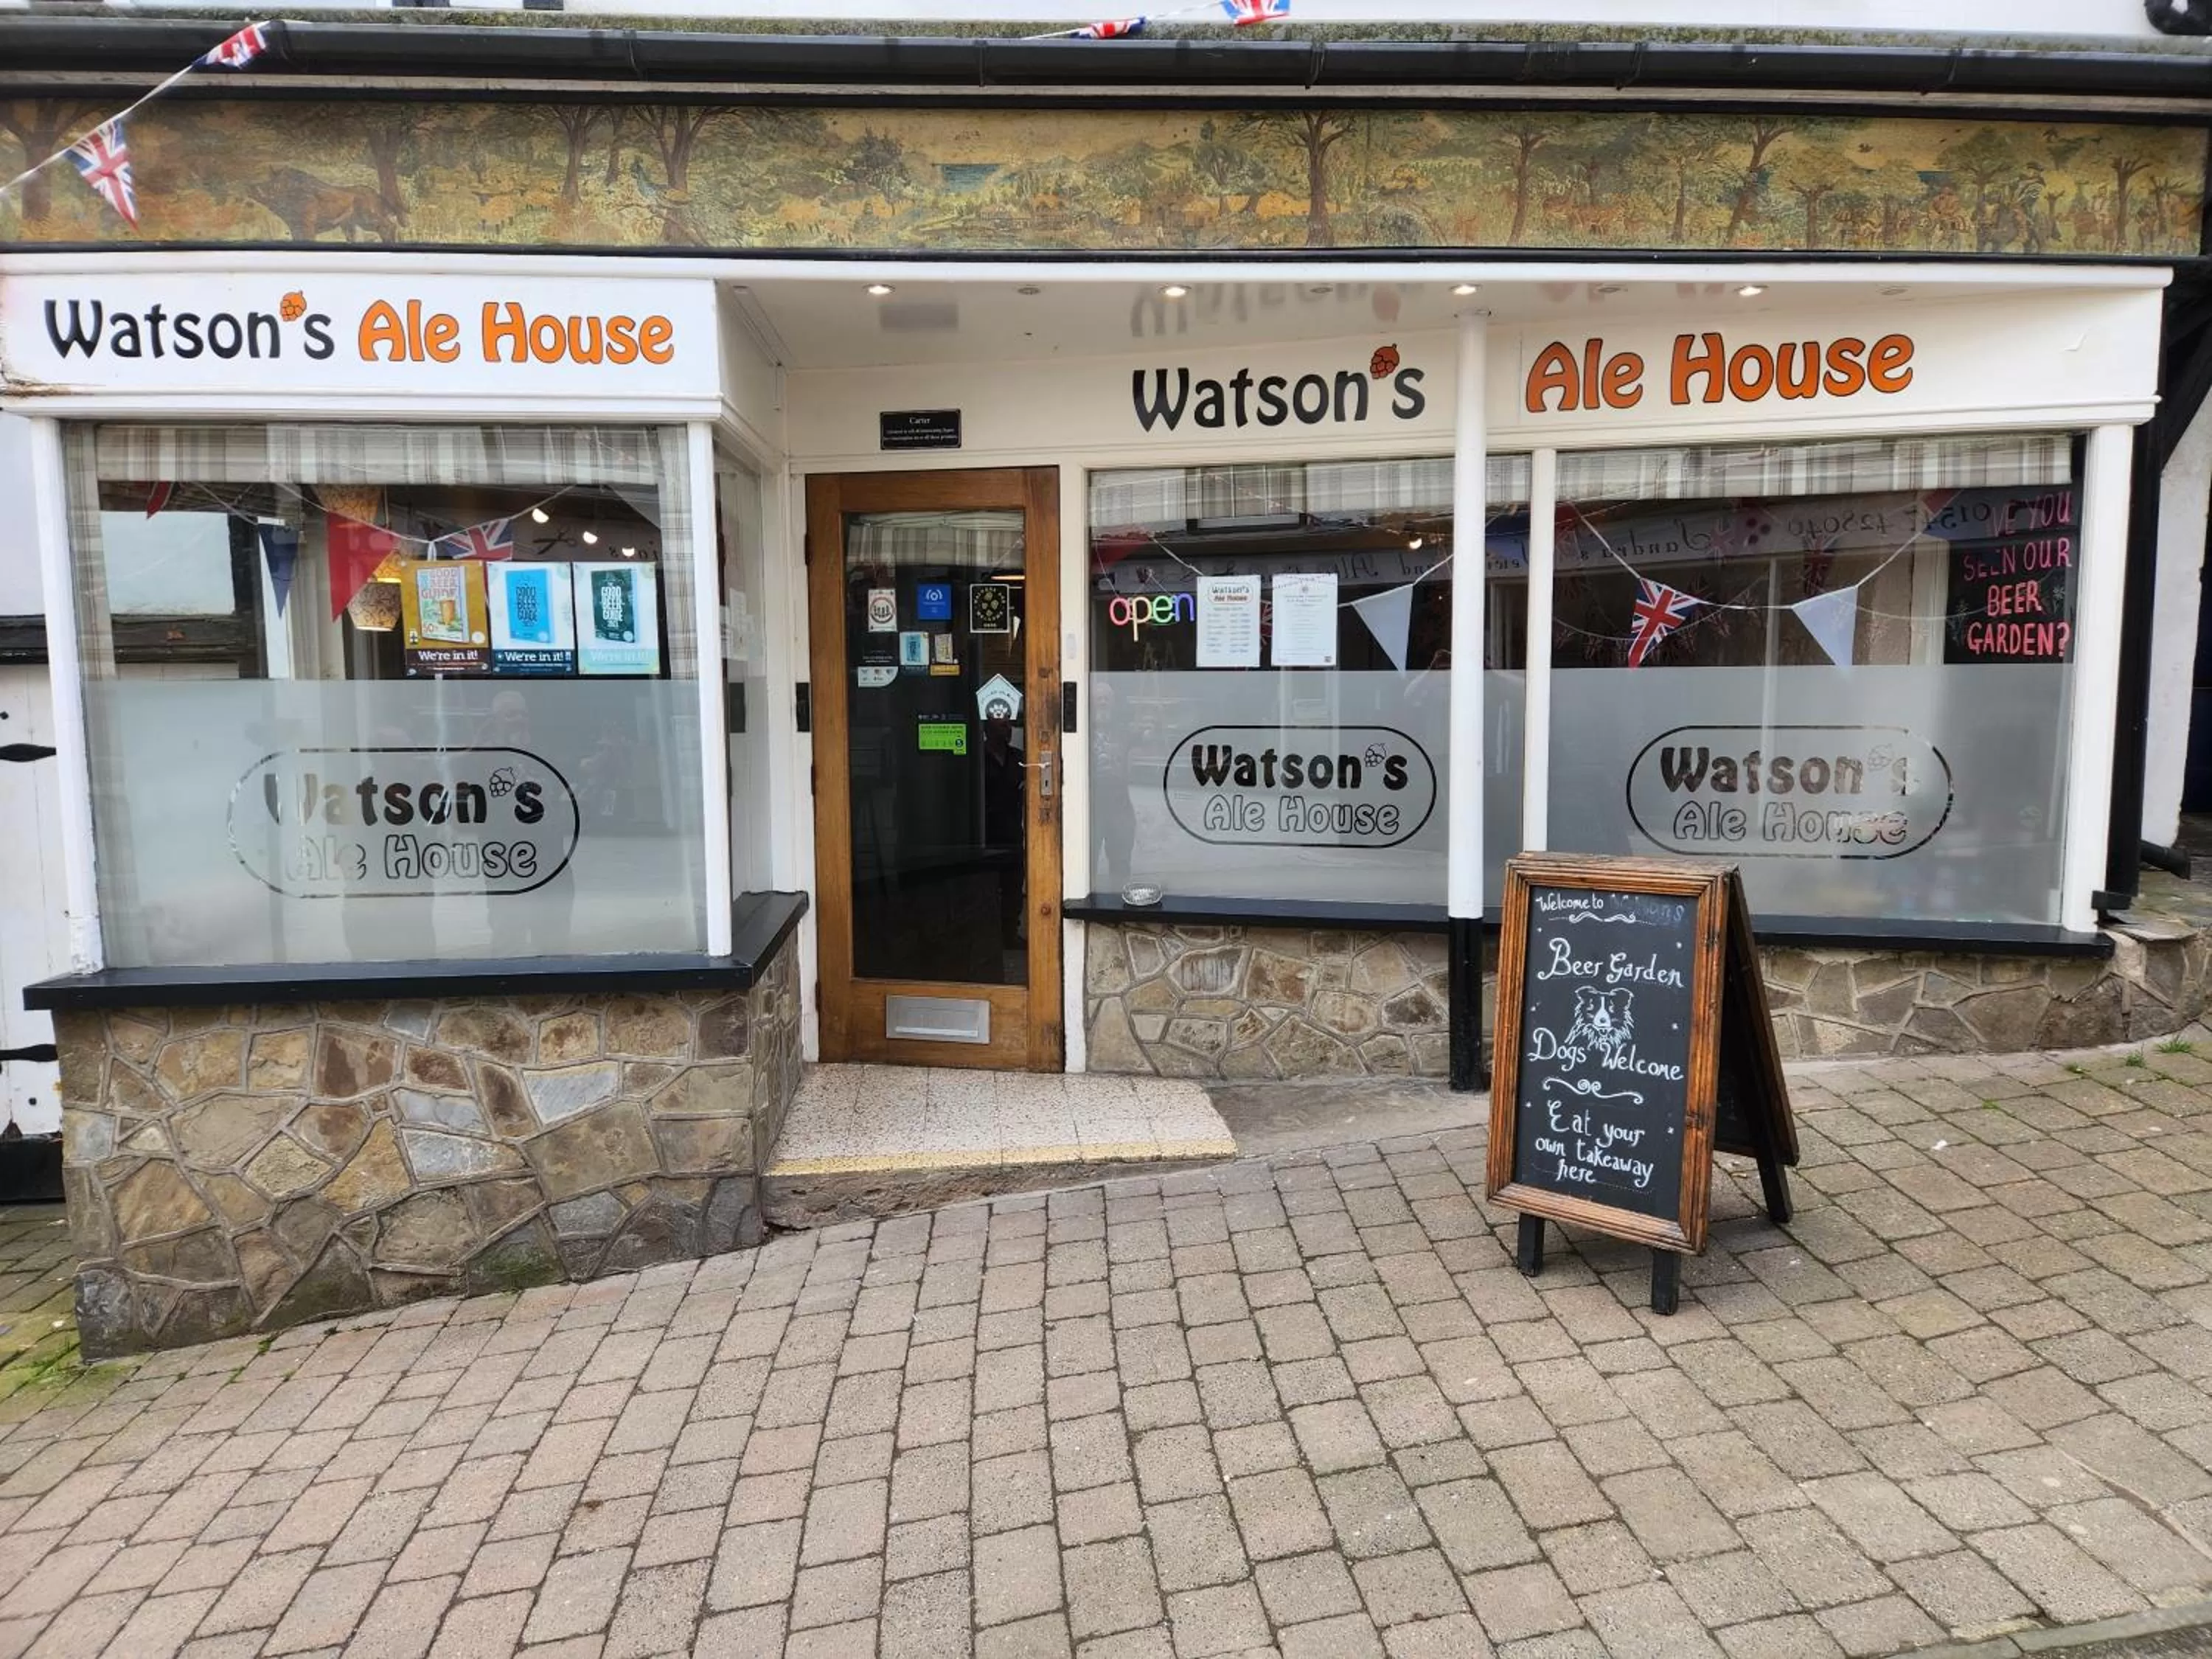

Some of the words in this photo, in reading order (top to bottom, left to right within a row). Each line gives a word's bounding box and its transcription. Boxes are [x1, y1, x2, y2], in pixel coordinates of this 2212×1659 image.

[44, 292, 335, 359] Watson's
[358, 299, 461, 363] Ale
[481, 301, 675, 365] House
[1132, 344, 1426, 431] Watson's
[1526, 340, 1645, 413] Ale
[1670, 333, 1916, 405] House
[2028, 490, 2071, 531] YOU
[2023, 538, 2073, 571] OUR
[1109, 592, 1196, 641] open
[1987, 580, 2042, 617] BEER
[418, 650, 449, 661] We're
[453, 650, 465, 660] in
[467, 649, 479, 660] it!
[504, 651, 537, 661] We're
[539, 651, 551, 661] in
[552, 650, 564, 661] it!
[1966, 621, 2071, 657] GARDEN?
[1191, 743, 1408, 790] Watson's
[1203, 795, 1265, 832] Ale
[1278, 796, 1400, 835] House
[1673, 801, 1747, 841] Ale
[1763, 801, 1909, 845] House
[286, 835, 366, 881] Ale
[384, 834, 538, 880] House
[1534, 893, 1590, 911] Welcome
[1591, 892, 1604, 910] to
[1537, 937, 1604, 981] Beer
[1606, 952, 1685, 988] Garden
[1527, 1027, 1587, 1071] Dogs
[1599, 1043, 1685, 1080] Welcome
[1547, 1099, 1592, 1136] Eat
[1595, 1123, 1646, 1147] your
[1535, 1137, 1566, 1156] own
[1576, 1138, 1654, 1188] takeaway
[1556, 1158, 1596, 1183] here
